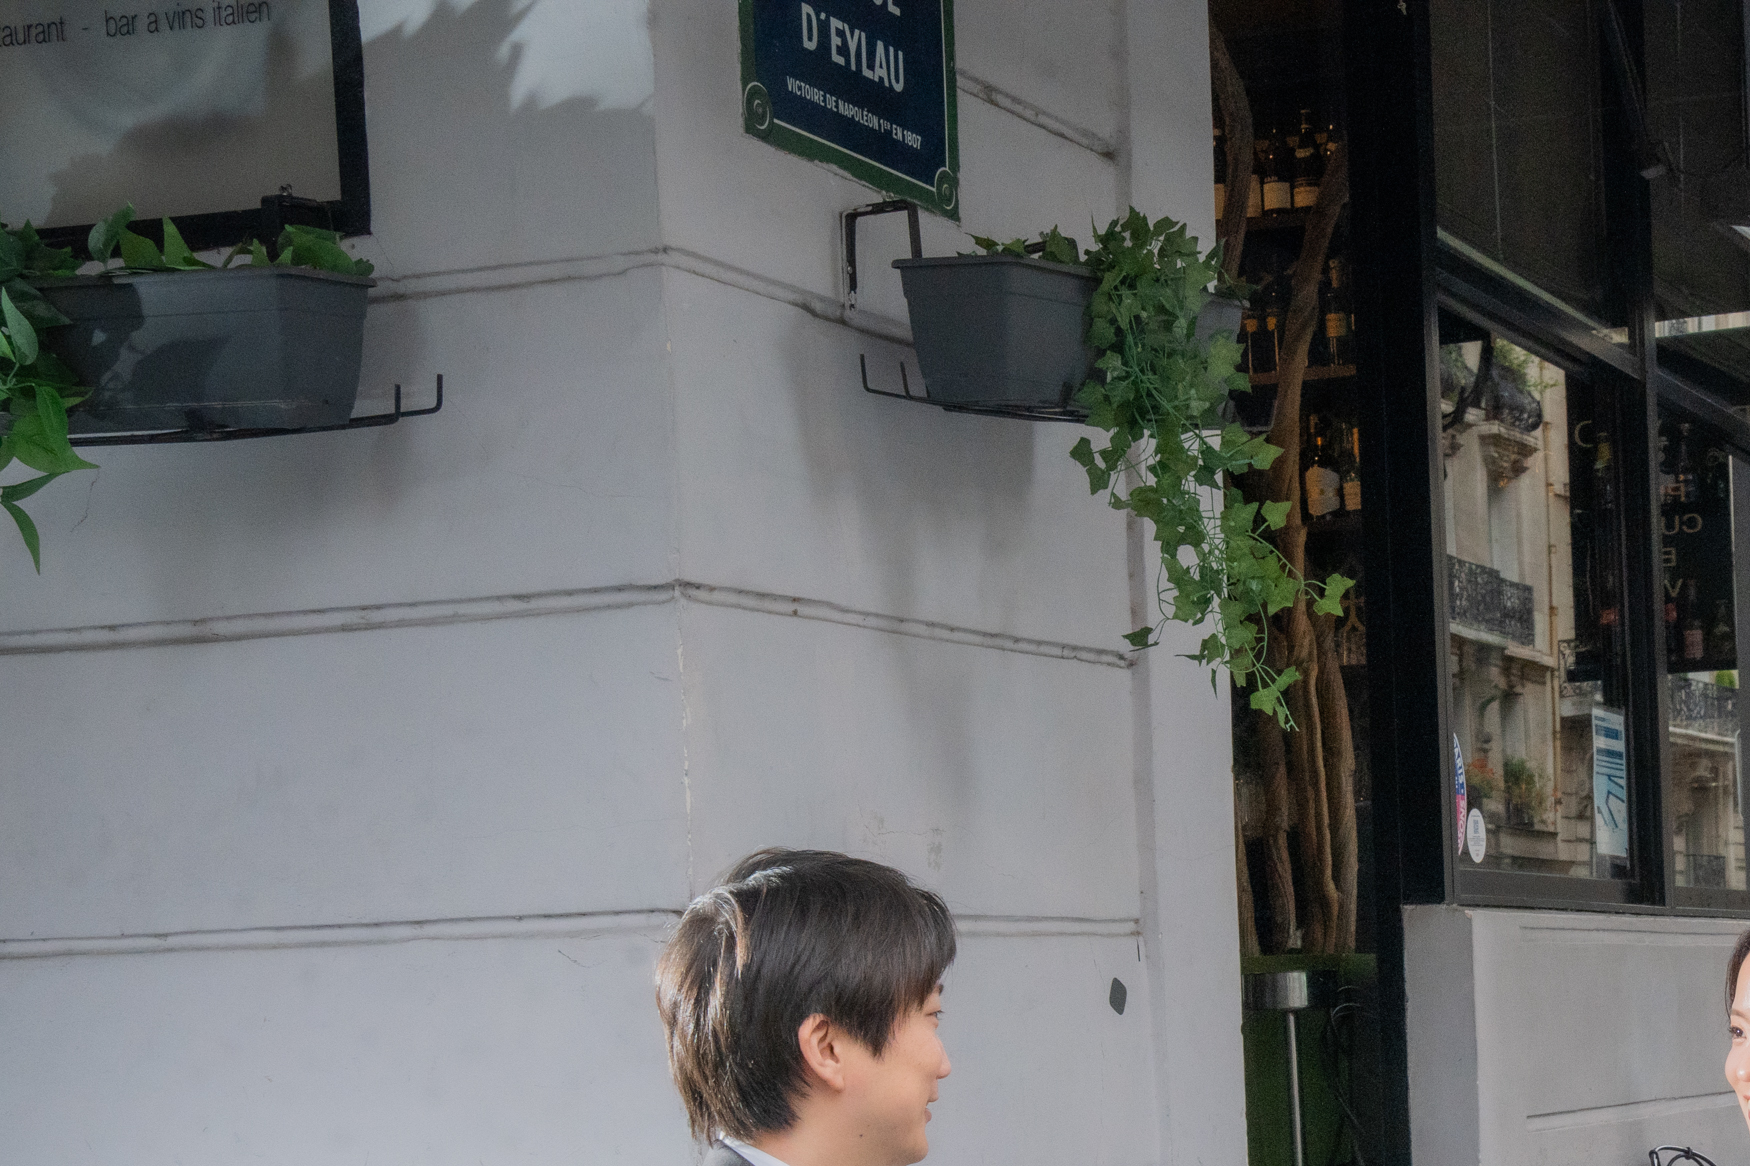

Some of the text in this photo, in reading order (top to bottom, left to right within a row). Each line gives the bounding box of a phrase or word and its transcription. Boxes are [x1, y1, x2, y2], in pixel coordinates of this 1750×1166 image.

[0, 16, 66, 47] aurant
[104, 10, 137, 37] bar
[164, 4, 205, 31] vins
[213, 0, 270, 27] italien
[801, 3, 905, 92] D'EYLAU
[786, 76, 825, 106] VICTOIRE
[826, 94, 837, 112] DE
[838, 99, 879, 131] NAPOLÉON
[892, 124, 902, 141] EN
[903, 130, 921, 150] 1807
